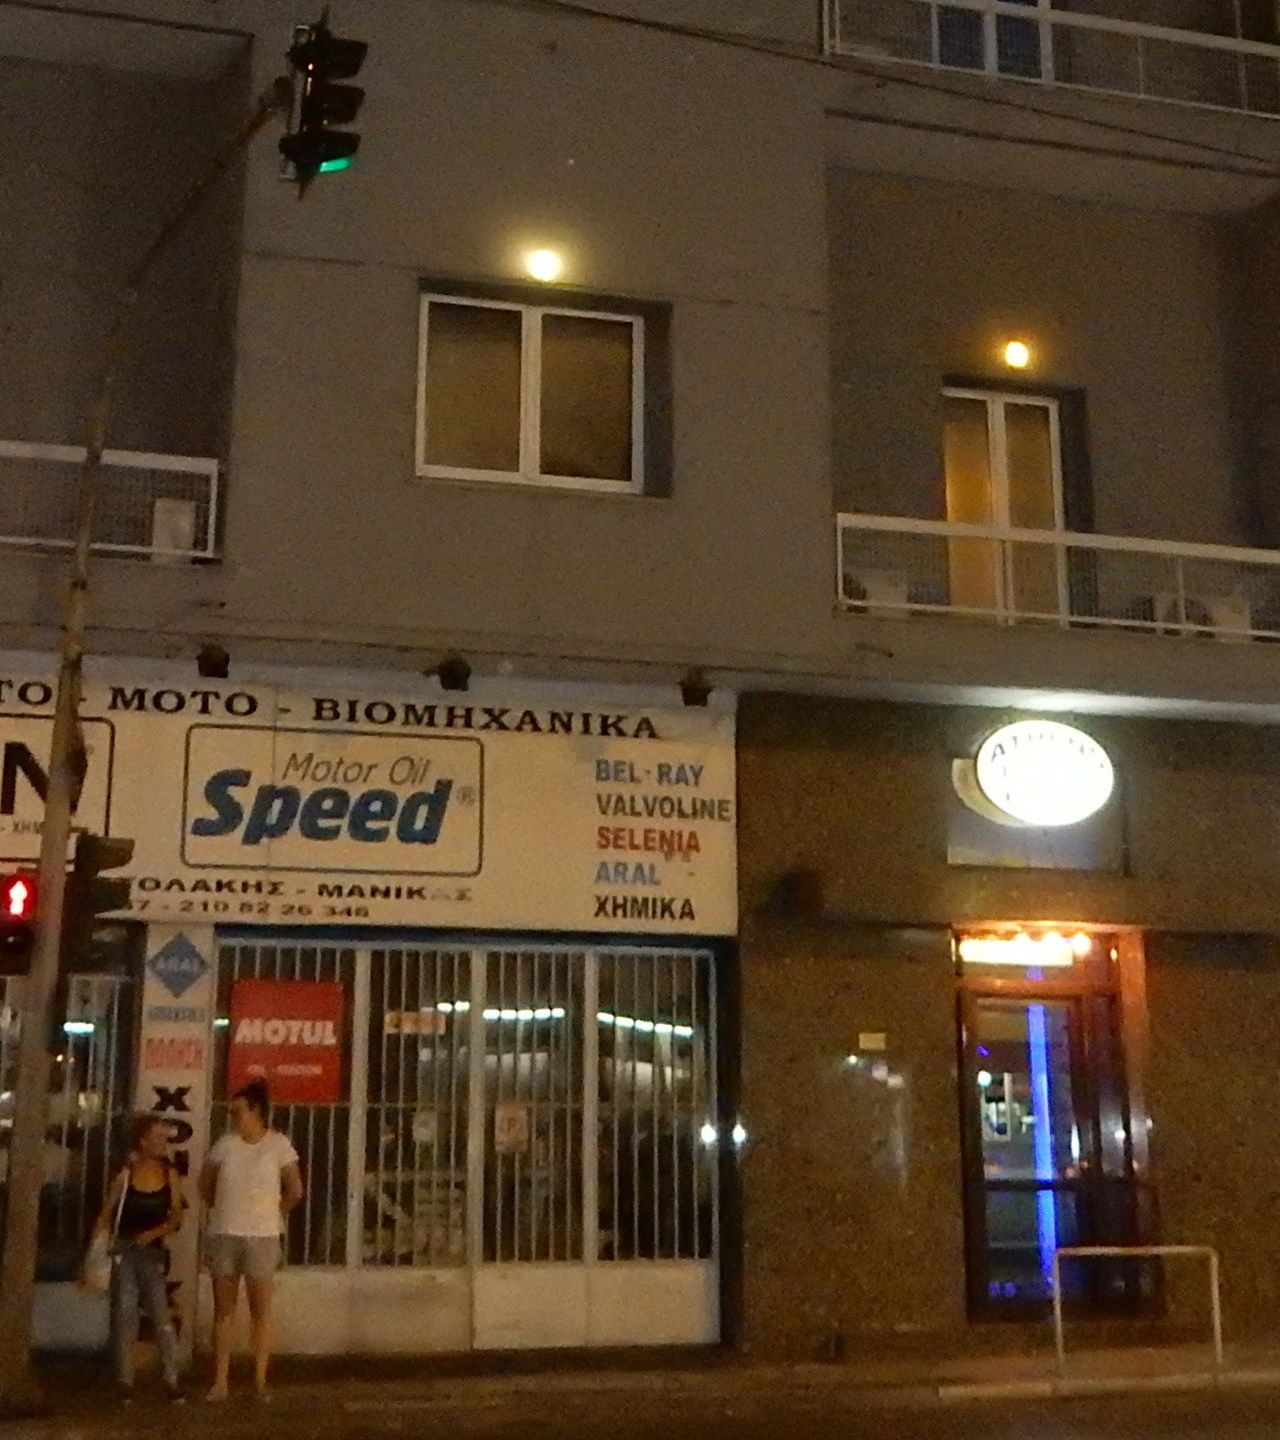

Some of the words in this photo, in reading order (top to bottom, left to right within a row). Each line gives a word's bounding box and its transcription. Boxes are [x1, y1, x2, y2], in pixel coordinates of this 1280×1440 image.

[107, 686, 259, 718] MOTO
[312, 697, 660, 740] ΒΙΟΜΗΧΑΝΙΚΑ
[282, 752, 375, 784] Motor
[388, 755, 431, 787] Oil
[191, 767, 454, 845] Speed
[595, 792, 732, 823] VALVOLINE
[596, 826, 701, 854] SELENIA
[595, 861, 662, 887] ARAL
[594, 895, 696, 921] ΧΗΜΙΚΑ
[234, 1017, 337, 1046] MOTUL
